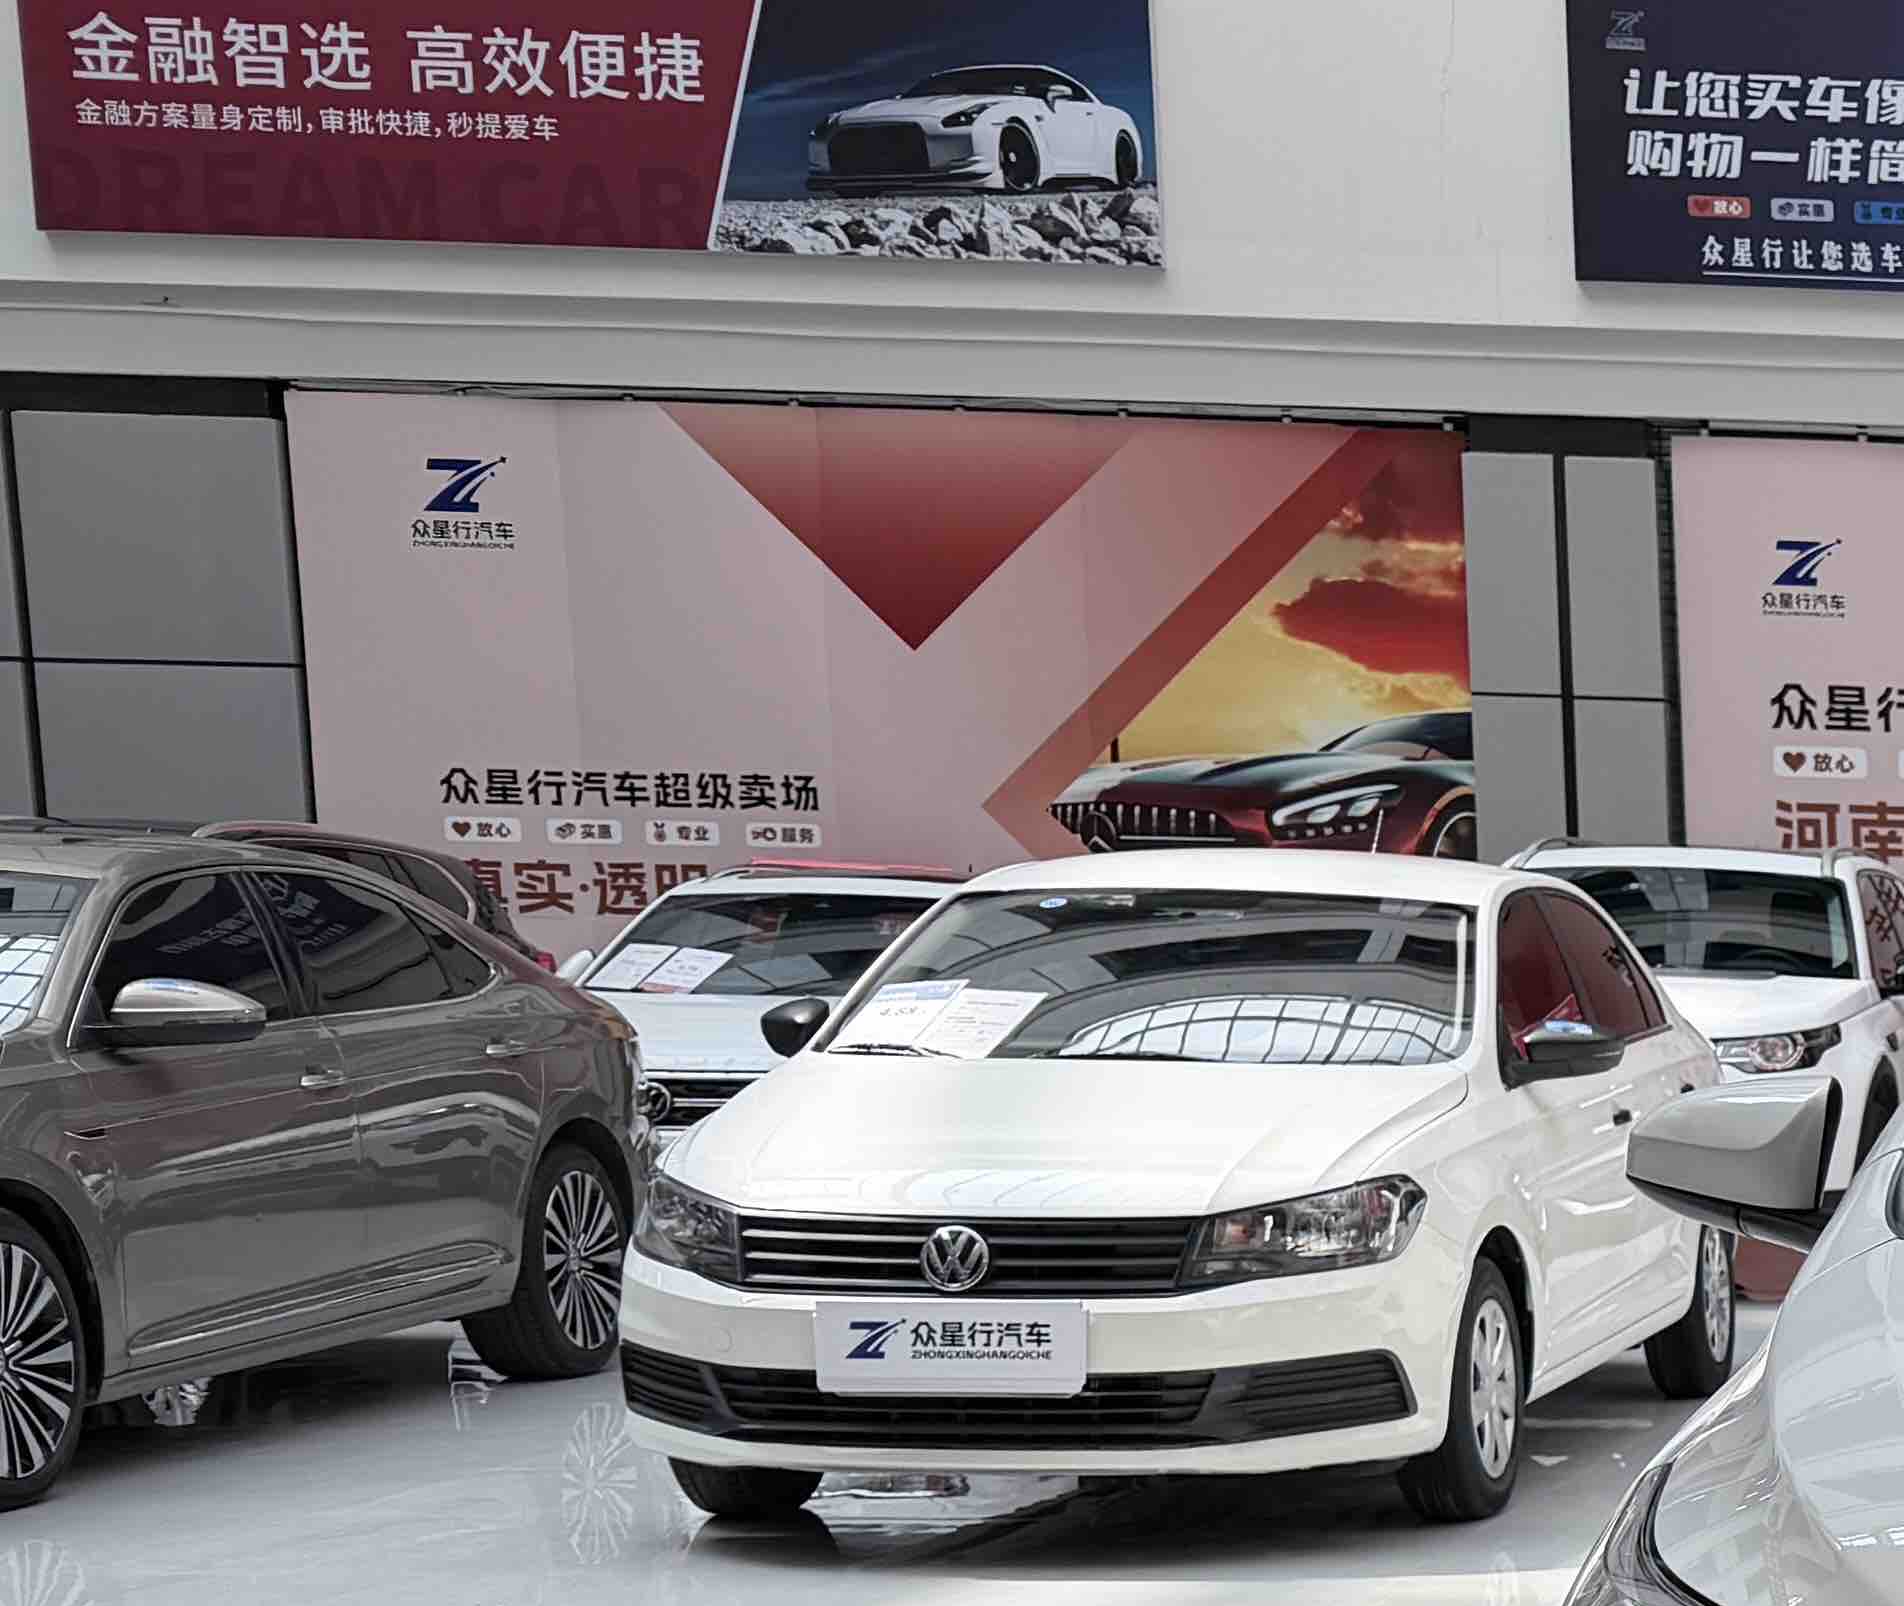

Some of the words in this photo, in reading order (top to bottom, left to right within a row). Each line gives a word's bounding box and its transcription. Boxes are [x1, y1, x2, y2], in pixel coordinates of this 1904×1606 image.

[66, 11, 373, 93] 金融智选
[407, 26, 705, 105] 高效便捷
[411, 519, 515, 540] 众星行汽车
[1762, 592, 1845, 609] 众星行汽车
[1813, 753, 1855, 773] 放心
[439, 768, 819, 811] 众星行汽车超级卖场
[477, 821, 512, 838] 放心
[677, 825, 709, 841] 专业
[910, 1321, 1052, 1347] 众星行汽车
